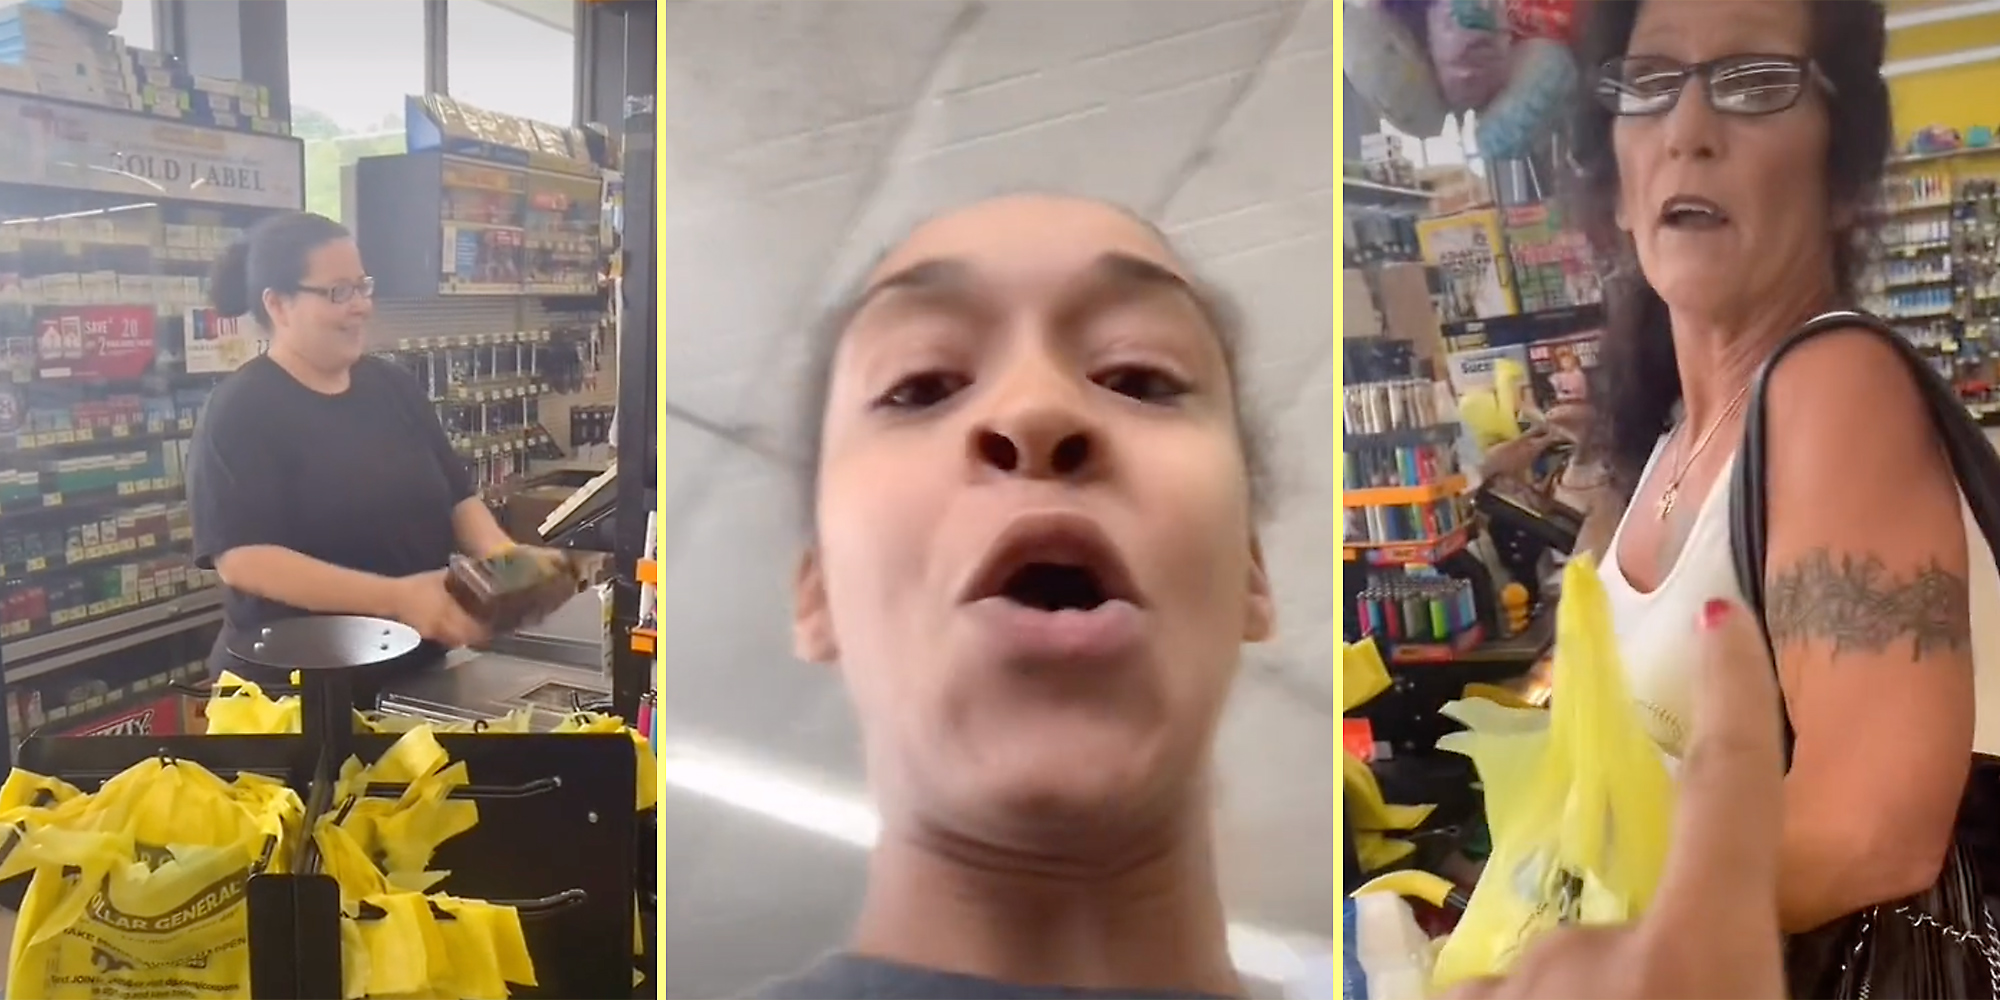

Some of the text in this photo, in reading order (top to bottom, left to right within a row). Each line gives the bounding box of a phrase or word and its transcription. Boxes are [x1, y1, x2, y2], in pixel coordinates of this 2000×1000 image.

[109, 151, 181, 182] GOLD
[189, 162, 266, 191] LABEL
[91, 879, 242, 930] OLLAR GENERAL
